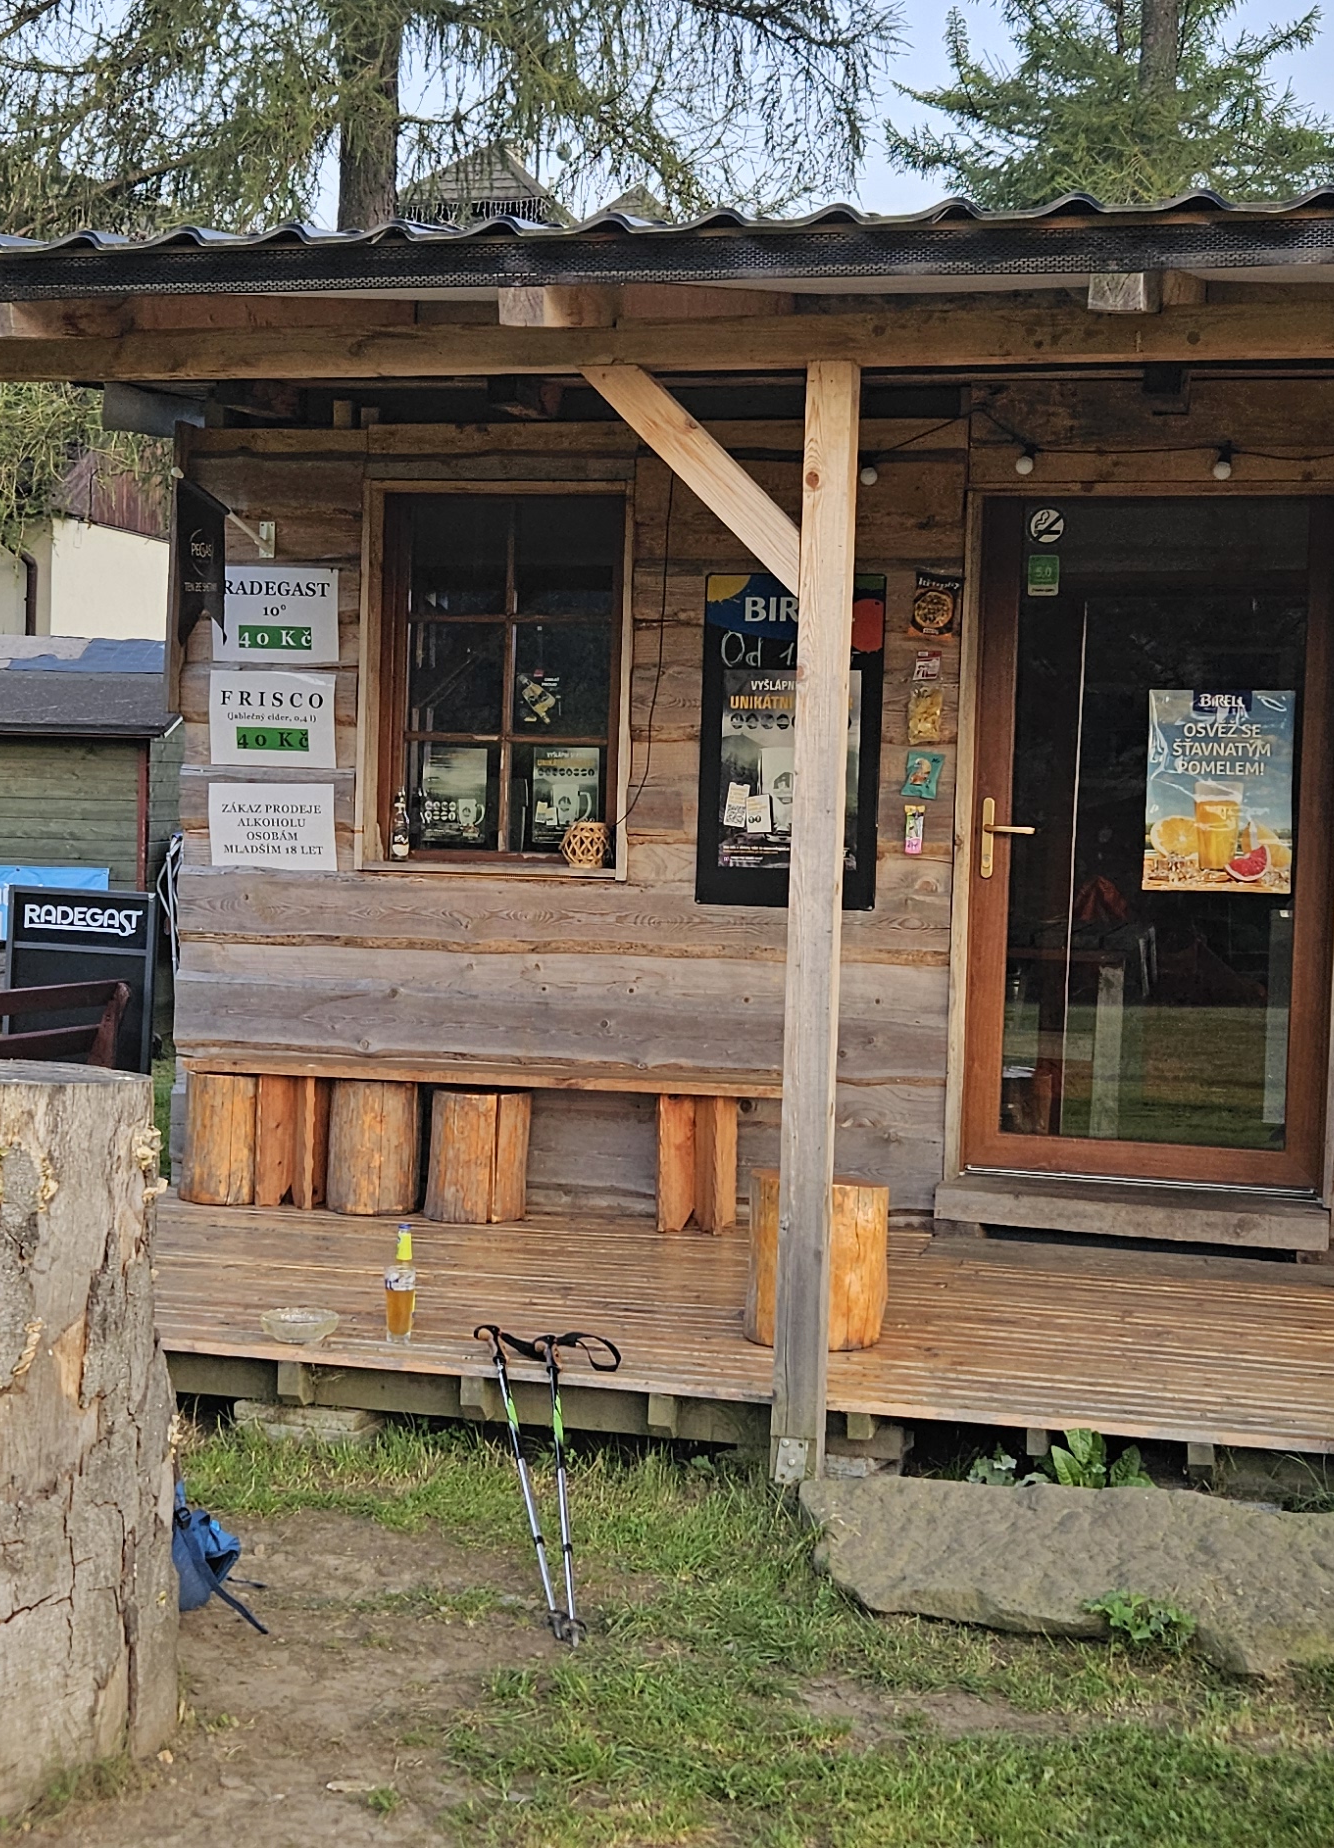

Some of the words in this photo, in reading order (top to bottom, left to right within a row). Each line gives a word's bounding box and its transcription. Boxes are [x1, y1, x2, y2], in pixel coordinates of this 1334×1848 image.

[224, 580, 330, 597] RADEGAST
[239, 631, 269, 648] 40
[280, 629, 312, 646] Kč
[721, 631, 762, 667] Od
[750, 678, 795, 691] VYŠLÁPN
[221, 690, 323, 709] FRISCO
[267, 714, 292, 722] cider,
[1184, 720, 1237, 737] OSVĚŽ
[1242, 723, 1262, 738] SE
[238, 733, 267, 749] 40
[278, 731, 308, 748] Kč
[1172, 738, 1271, 757] ŠŤAVNATÝM
[1178, 761, 1265, 776] POMELEM!
[222, 802, 262, 813] ZÁKAZ
[265, 804, 322, 814] PRODEJE
[237, 817, 306, 827] ALKOHOLU
[246, 830, 298, 841] OSOBÁM
[224, 844, 281, 854] MLADŠÍM
[301, 846, 323, 855] LET
[24, 903, 143, 936] RADEGAST
